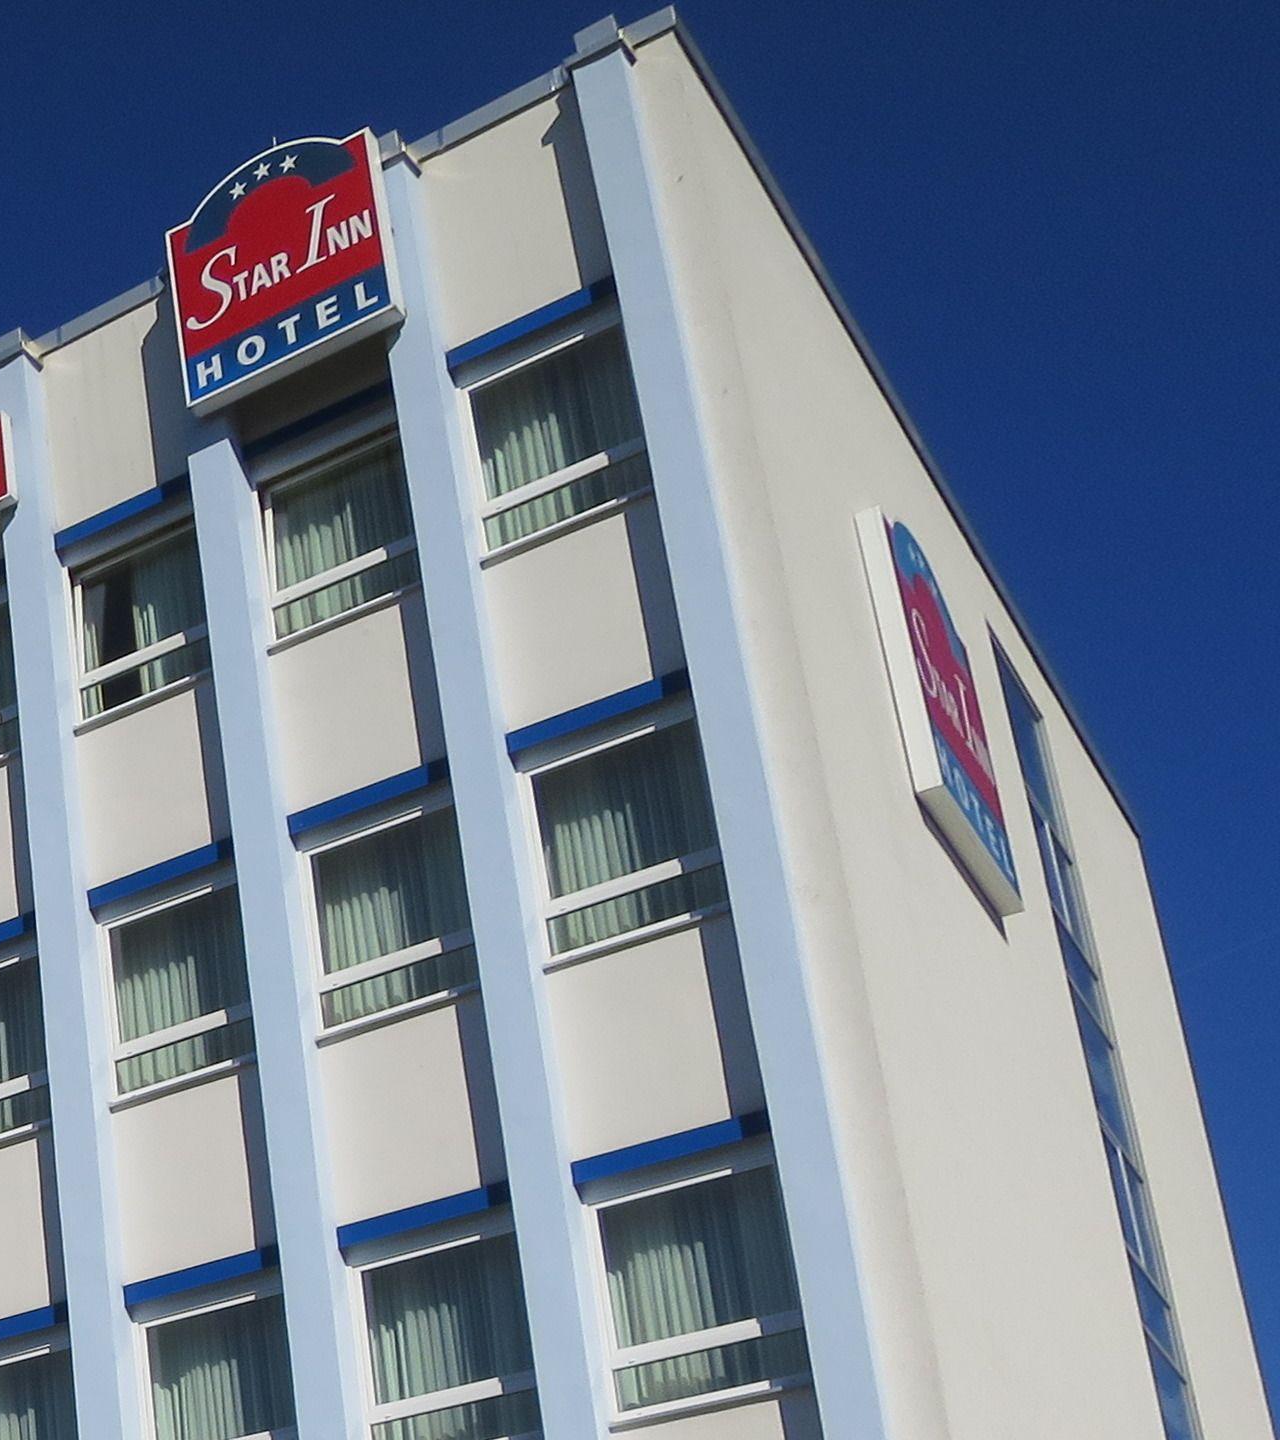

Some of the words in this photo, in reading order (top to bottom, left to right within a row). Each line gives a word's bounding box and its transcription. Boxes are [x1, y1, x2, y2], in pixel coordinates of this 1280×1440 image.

[186, 246, 291, 330] STAR
[297, 194, 373, 273] INN
[196, 281, 379, 389] HOTEL
